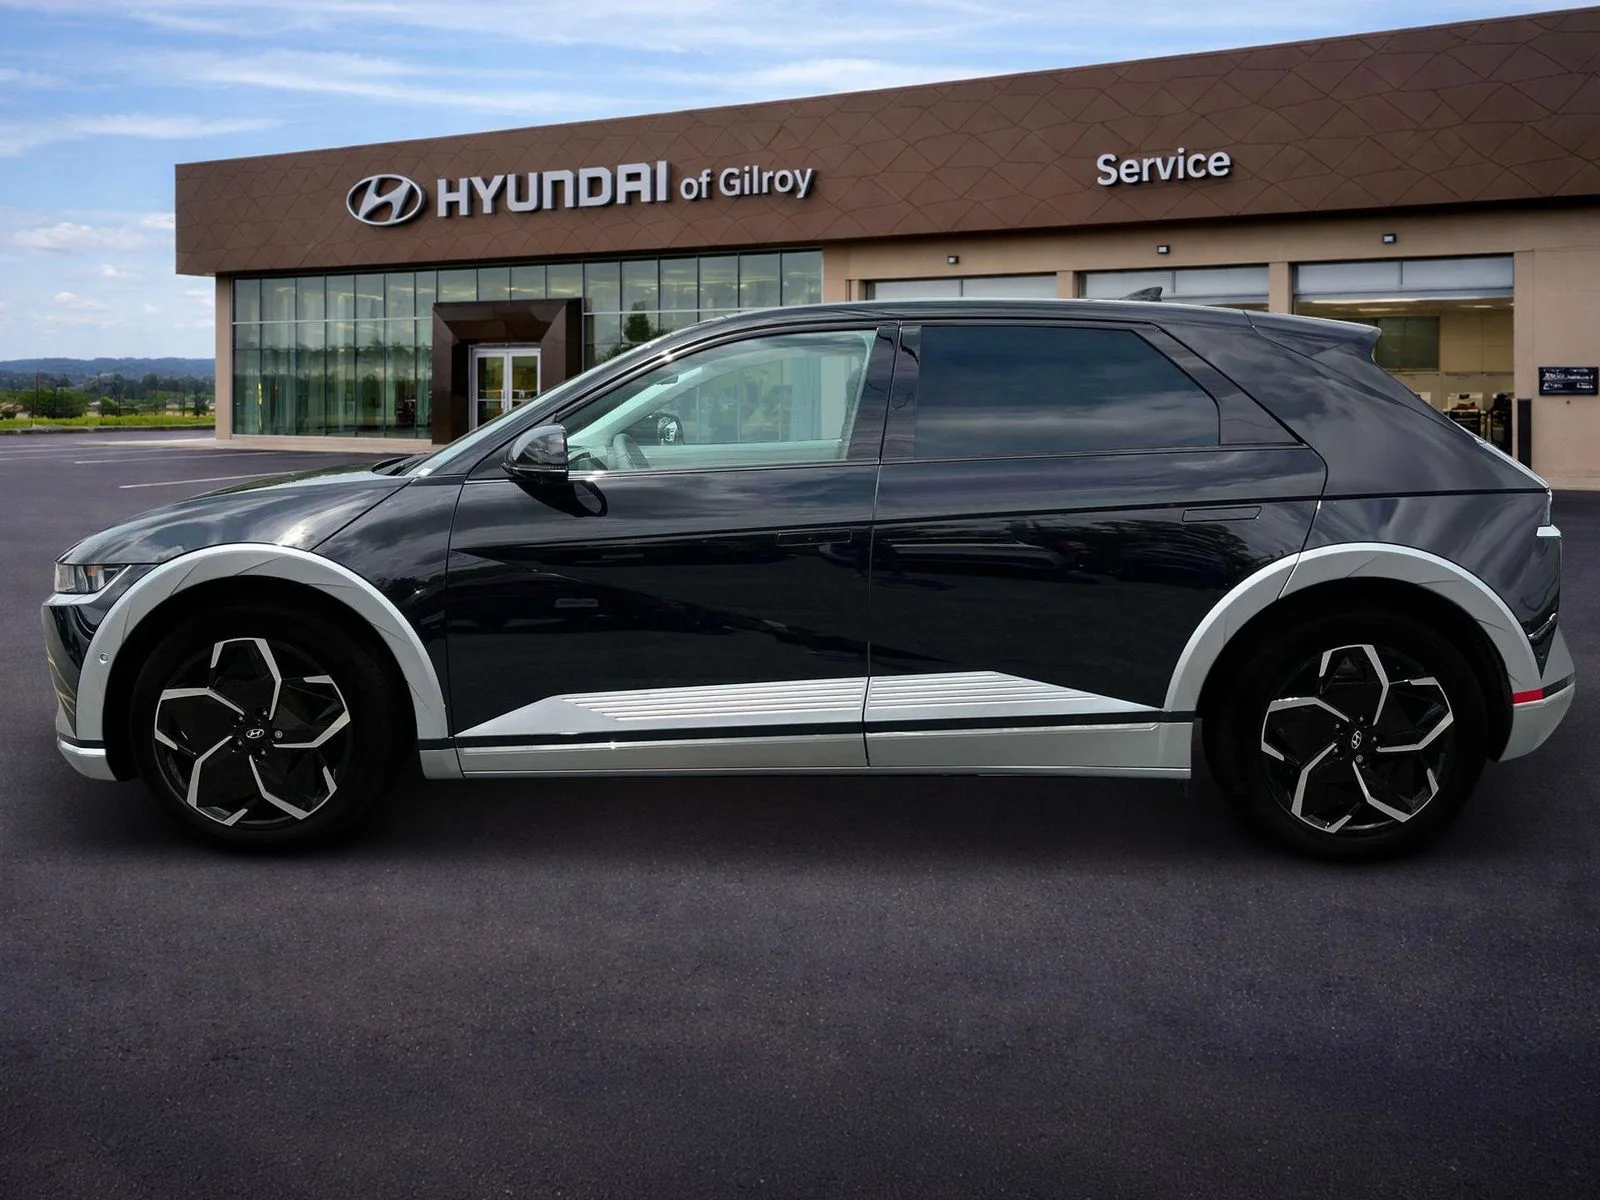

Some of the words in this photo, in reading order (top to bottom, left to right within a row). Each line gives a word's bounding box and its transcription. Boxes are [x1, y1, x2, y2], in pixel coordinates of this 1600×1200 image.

[436, 160, 668, 217] HYUNDAI
[679, 168, 712, 200] of
[718, 164, 814, 199] Gilroy
[1096, 147, 1231, 186] Service
